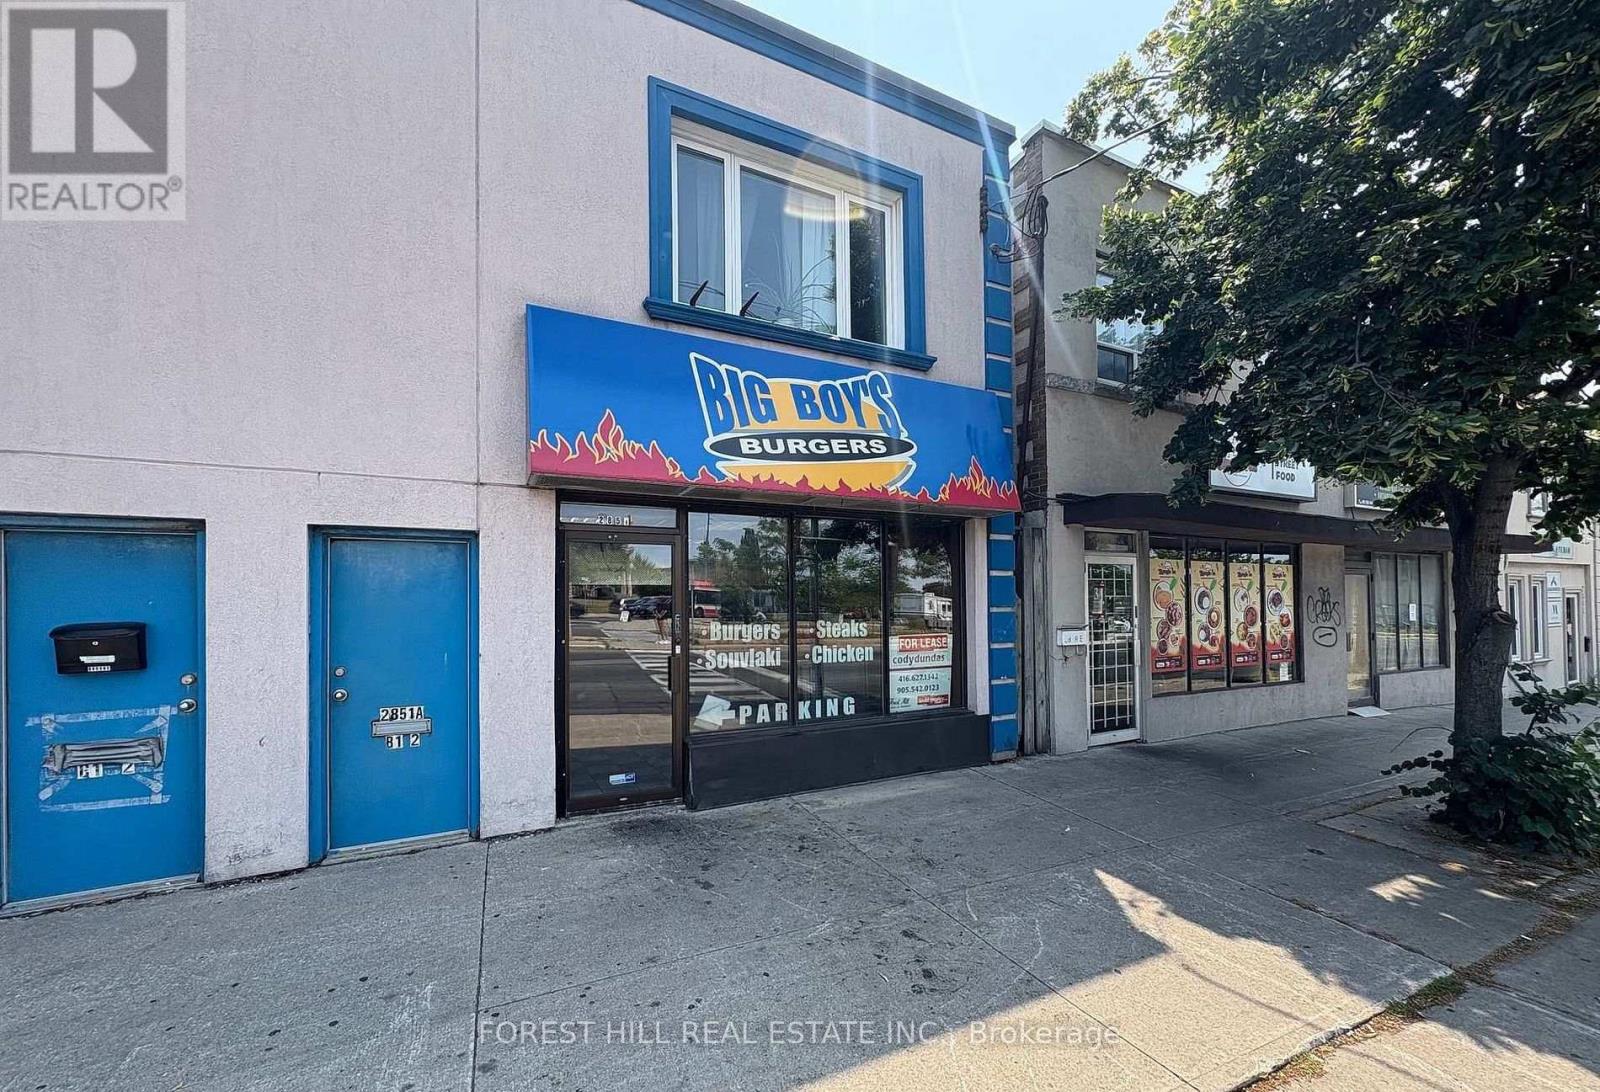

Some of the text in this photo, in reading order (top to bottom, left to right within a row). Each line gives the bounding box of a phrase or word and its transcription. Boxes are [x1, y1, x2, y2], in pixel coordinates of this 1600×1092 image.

[691, 354, 905, 438] BIG BOY'S
[739, 437, 888, 456] BURGERS
[1275, 470, 1296, 482] FOOD
[709, 621, 782, 643] Burgers
[816, 619, 869, 639] Steaks
[899, 636, 948, 649] FOR LEASE
[705, 647, 781, 670] Souvlaki
[811, 645, 875, 664] Chicken
[892, 653, 945, 666] codydundas
[380, 707, 423, 721] 2851A
[739, 697, 856, 725] PARKING
[410, 733, 420, 747] 2
